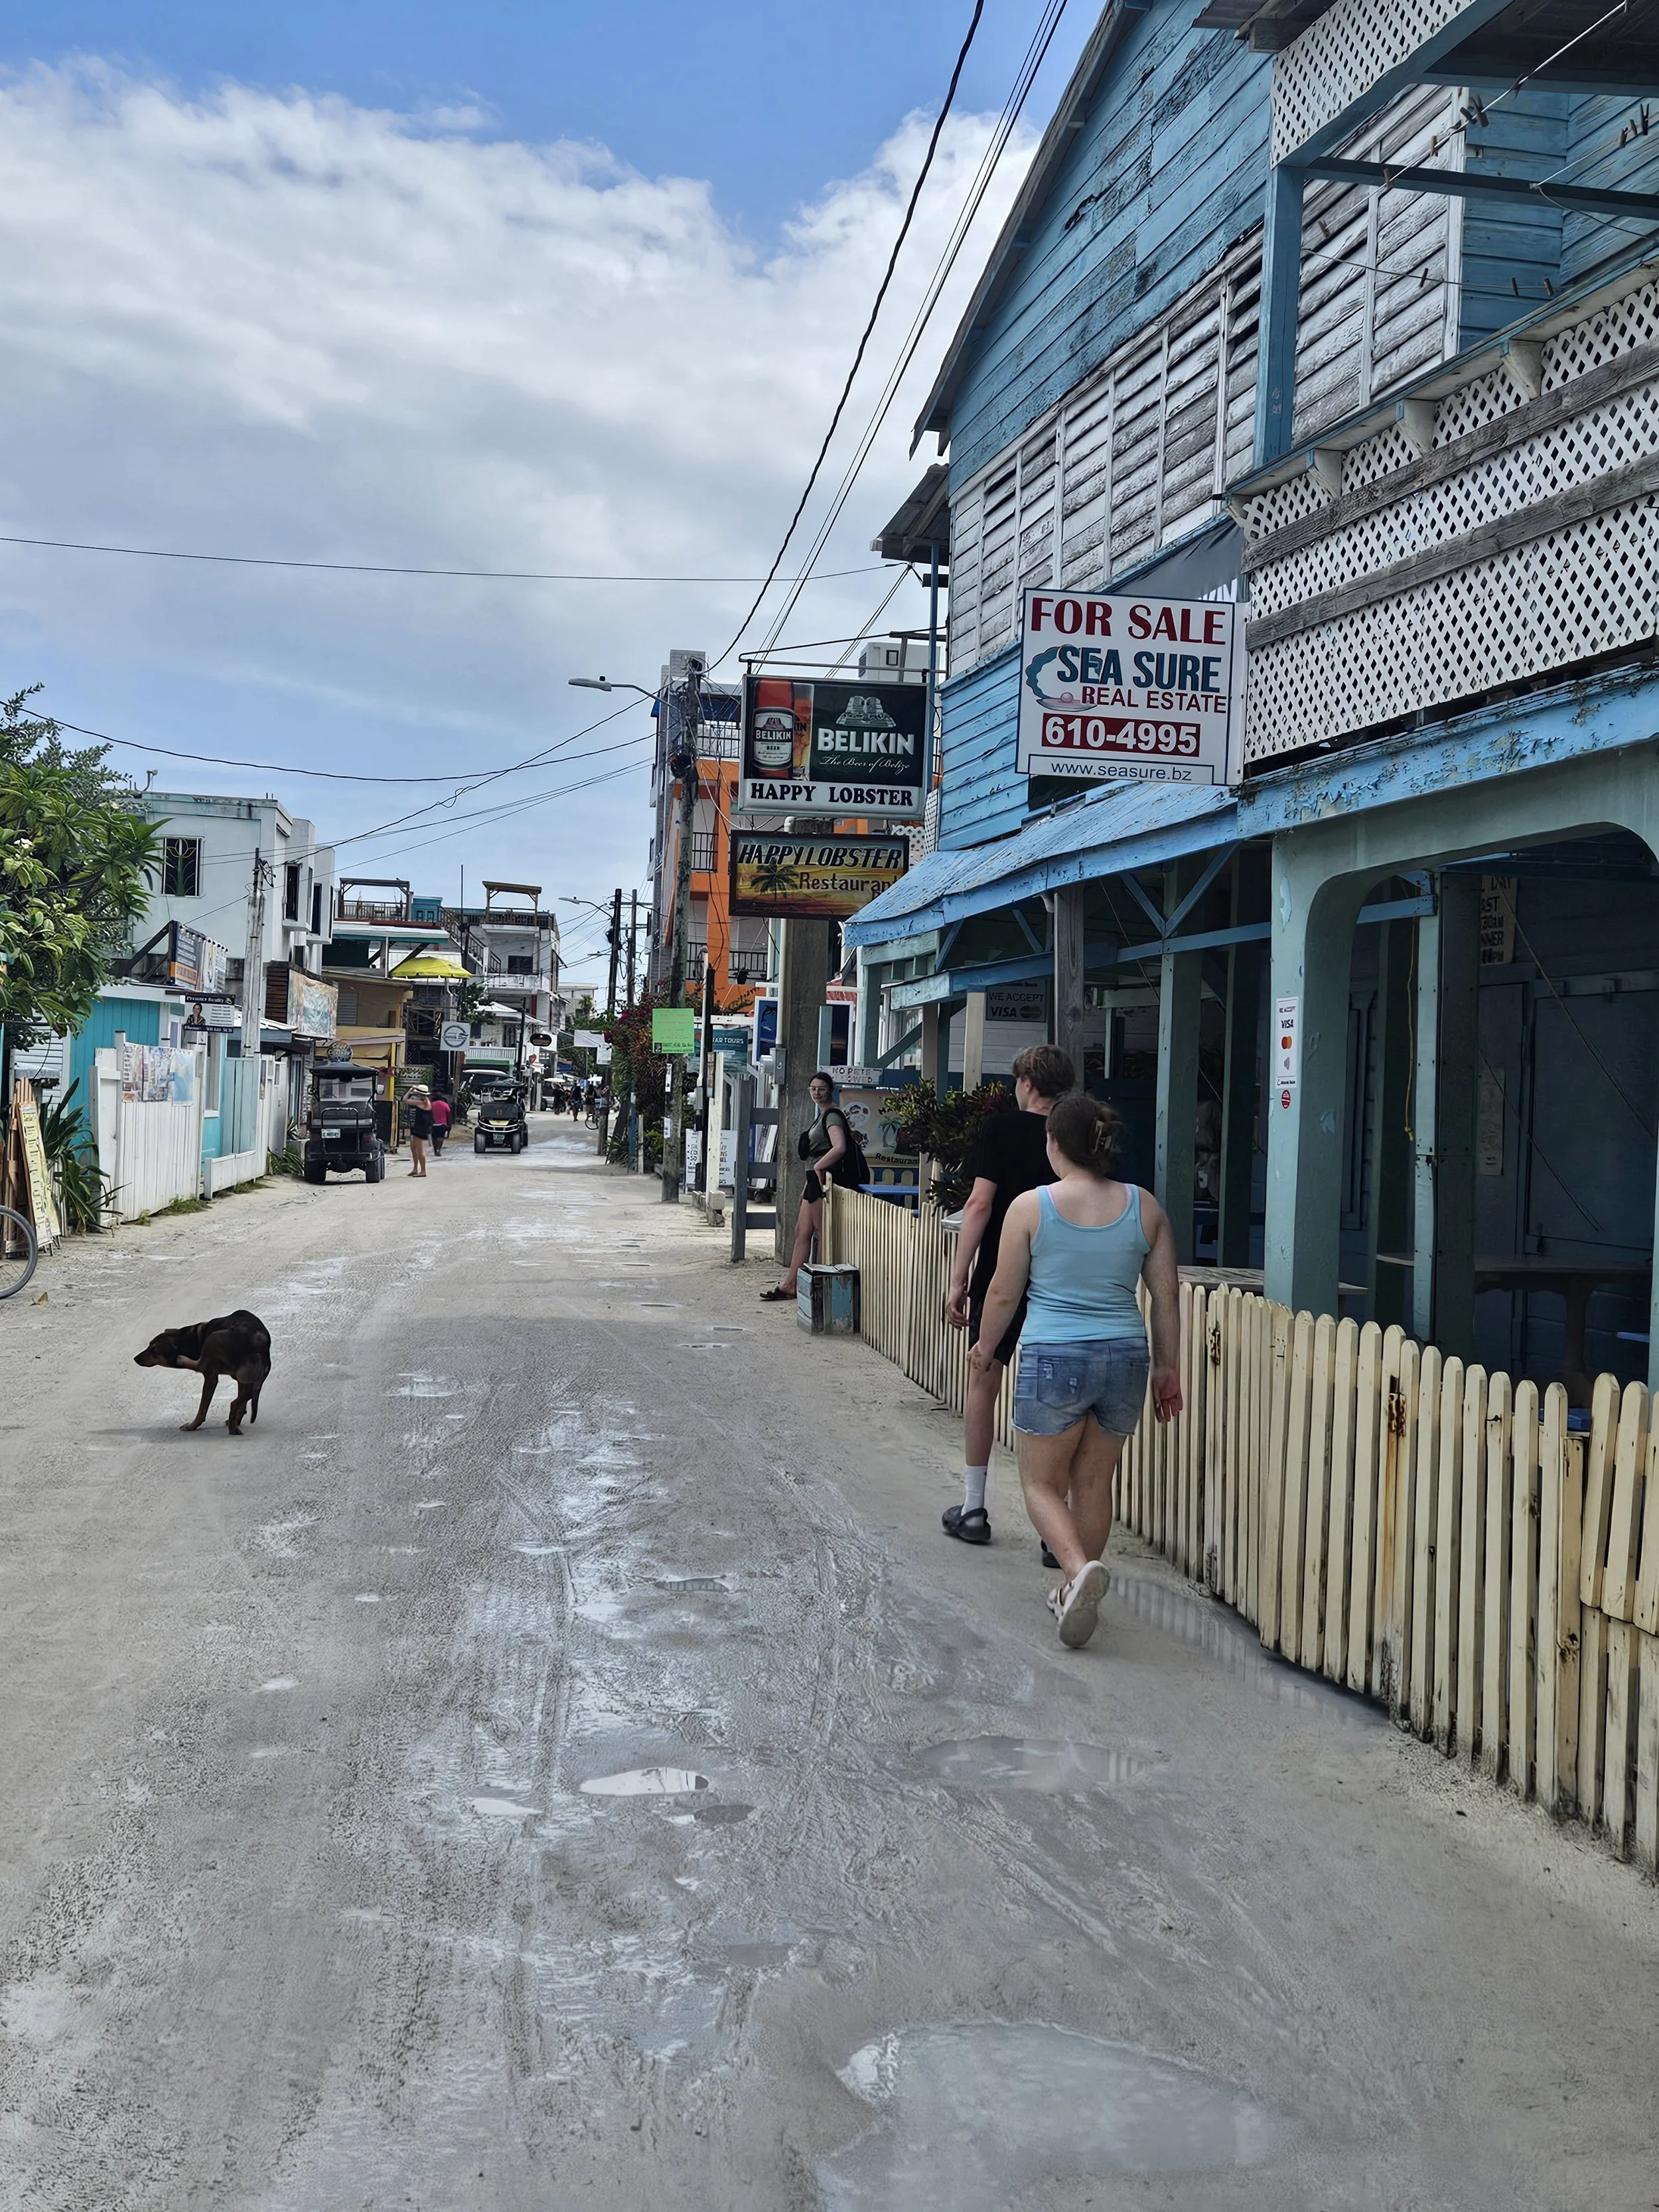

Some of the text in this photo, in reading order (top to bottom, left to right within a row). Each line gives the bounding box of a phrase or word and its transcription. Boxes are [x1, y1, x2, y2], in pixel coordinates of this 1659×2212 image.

[1031, 597, 1226, 645] FOR SALE
[1056, 644, 1222, 694] SEA SURE
[1082, 686, 1227, 714] REAL ESTATE
[756, 729, 792, 740] BELIKIN
[817, 727, 915, 755] BELIKIN
[1045, 716, 1197, 755] 610-4995
[819, 755, 841, 765] The
[868, 756, 885, 773] of
[879, 759, 910, 774] Belize
[1051, 761, 1192, 781] www.seasure.bz
[751, 782, 914, 807] HAPPY LOBSTER
[738, 844, 902, 869] HAPPY LOBSTER
[989, 992, 1045, 1002] WE ACCEPT
[990, 1007, 1017, 1017] VISA
[875, 1153, 918, 1165] Restauran
